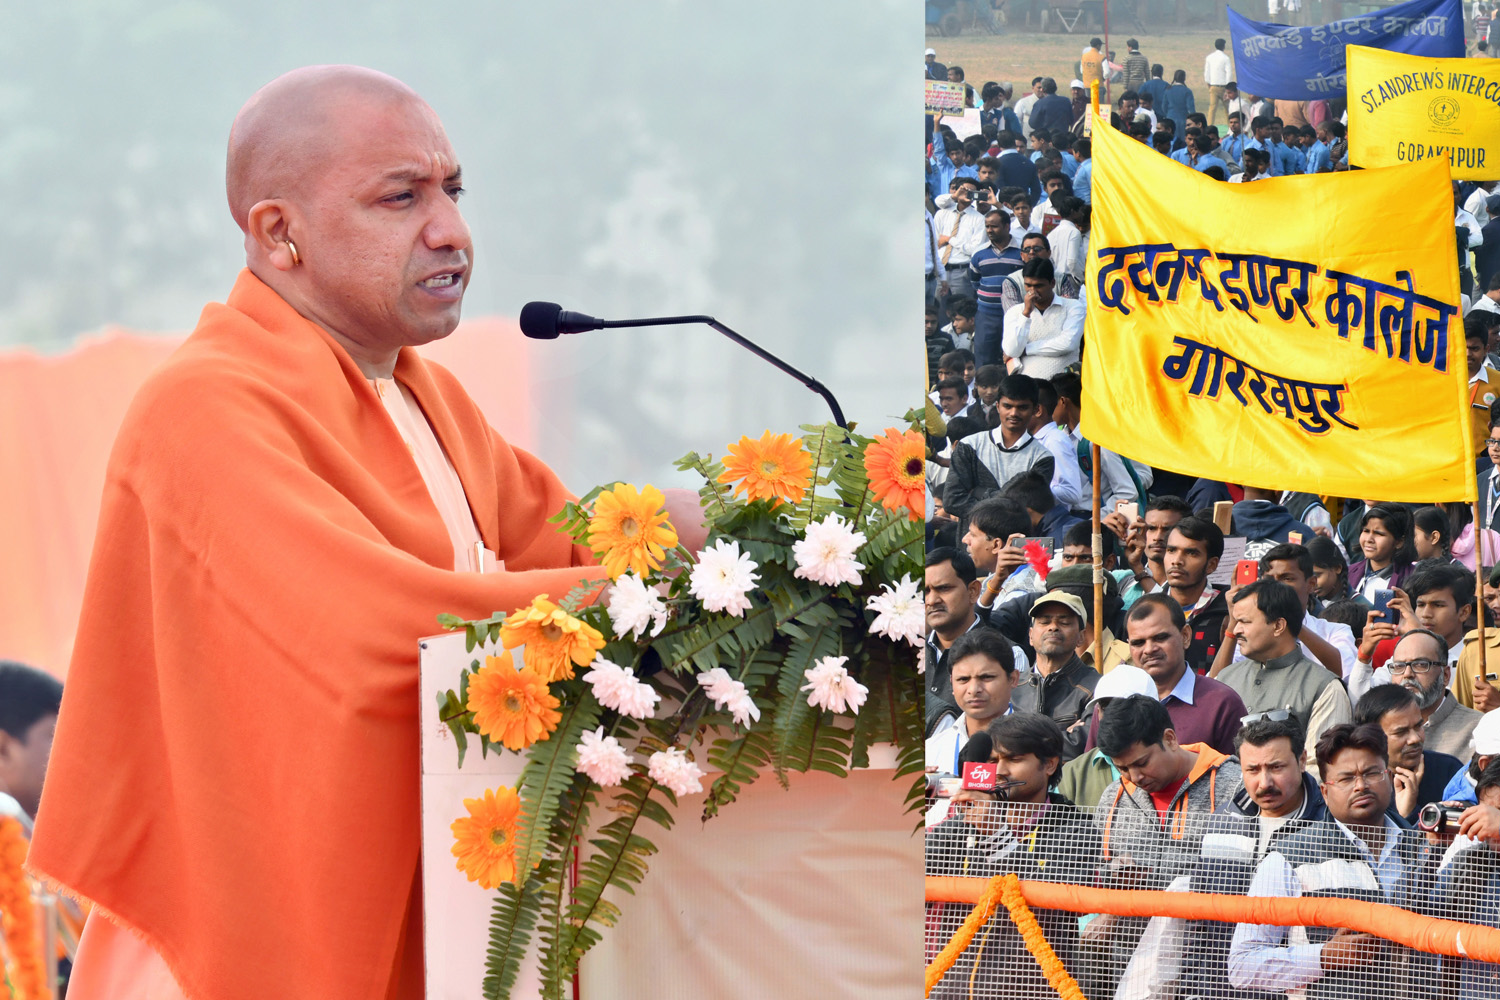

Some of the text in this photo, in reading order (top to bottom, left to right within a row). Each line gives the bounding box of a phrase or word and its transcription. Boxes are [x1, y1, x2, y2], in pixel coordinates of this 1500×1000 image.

[1448, 72, 1485, 97] INTER
[1214, 251, 1320, 329] इण्टर
[1323, 268, 1461, 374] कालेज
